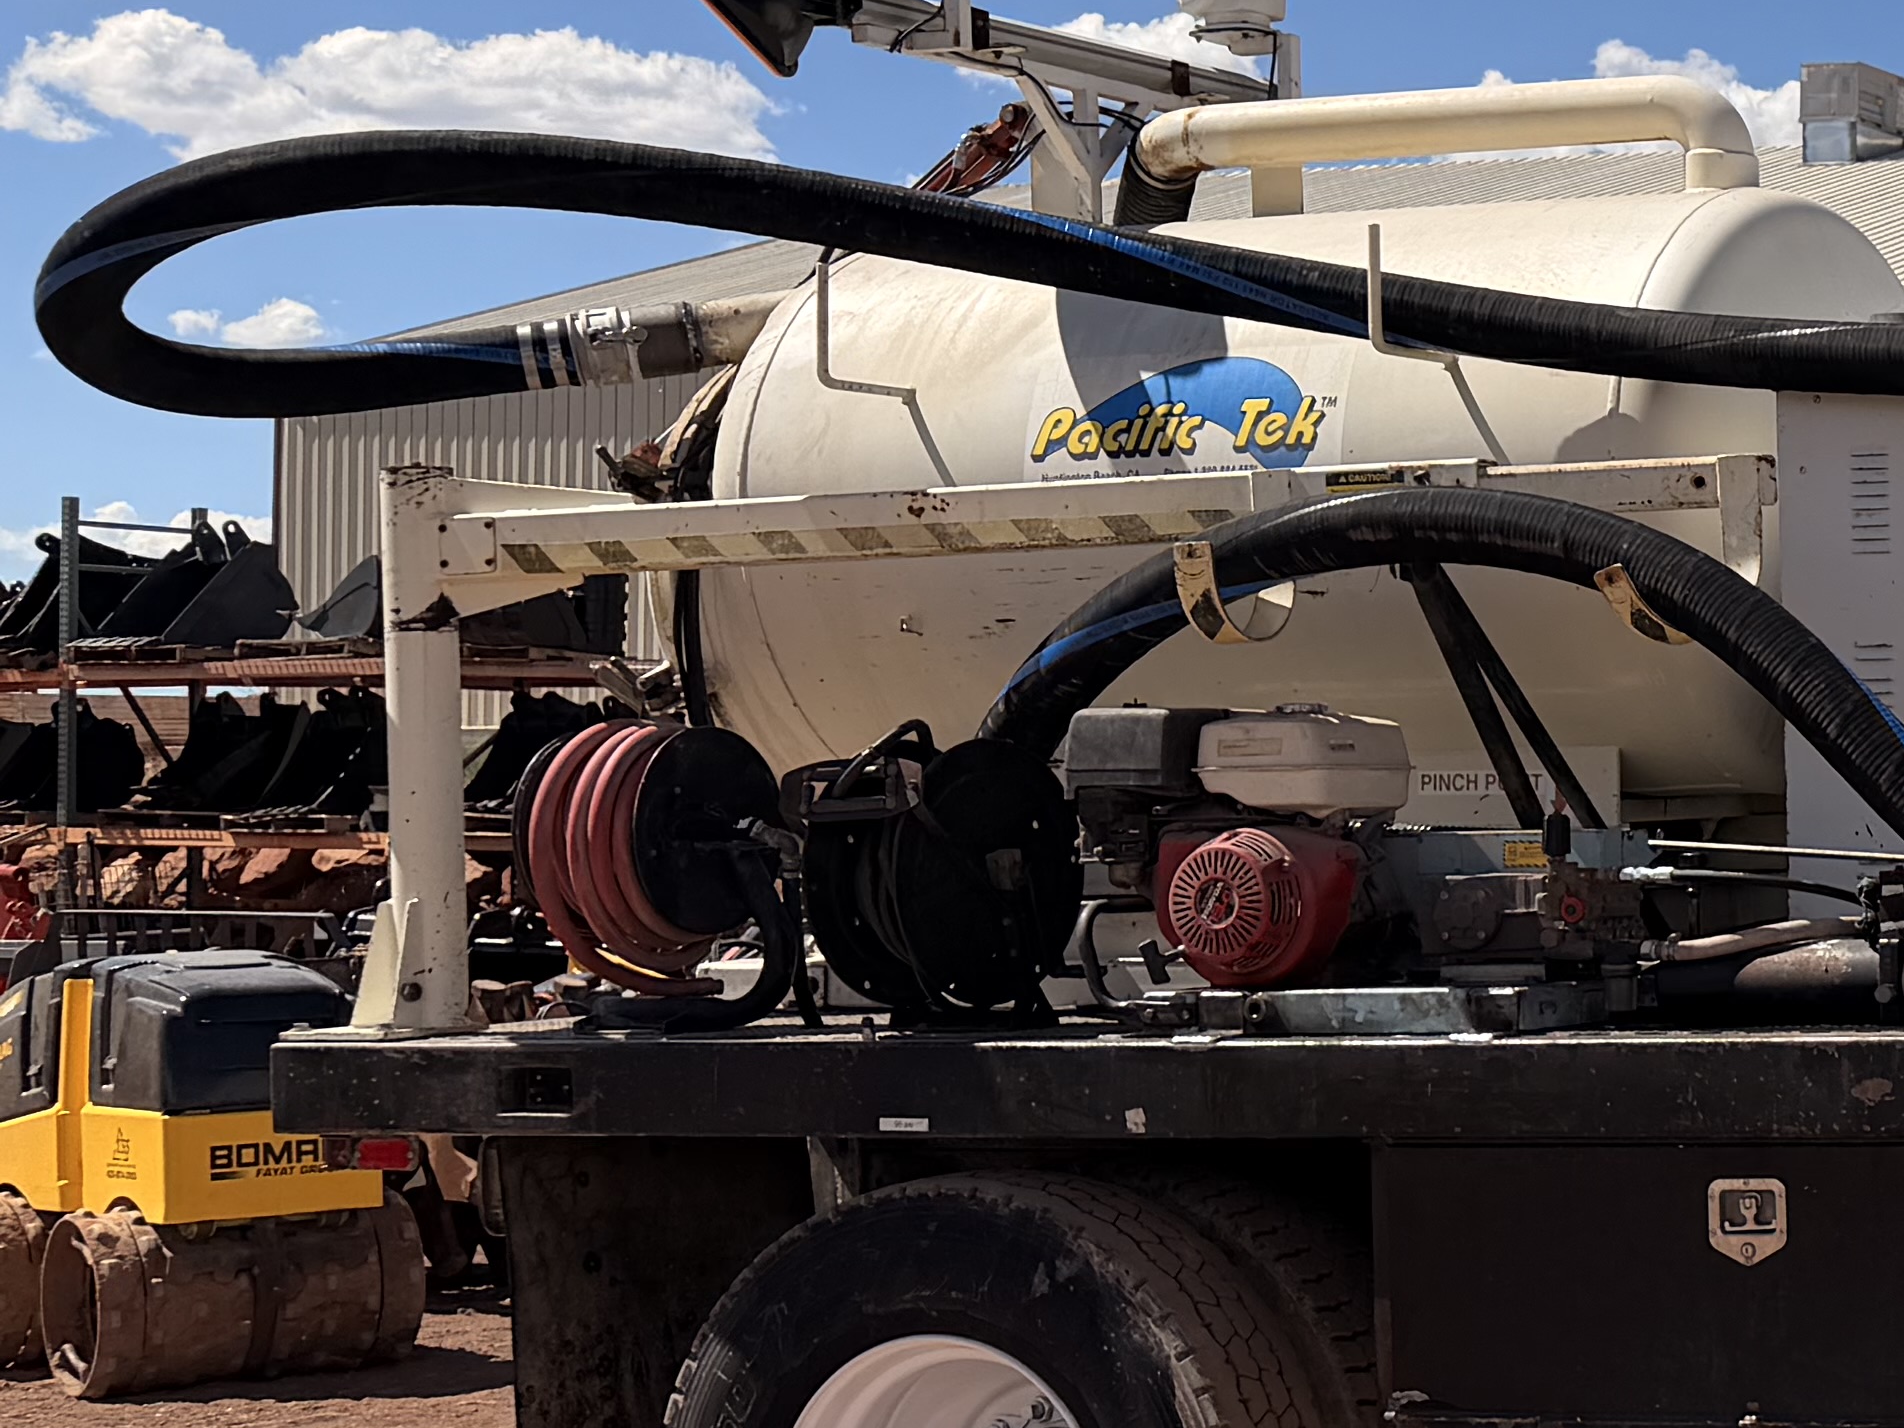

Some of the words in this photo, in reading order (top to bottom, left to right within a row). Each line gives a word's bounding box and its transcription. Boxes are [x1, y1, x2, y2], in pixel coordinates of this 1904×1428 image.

[1031, 401, 1203, 462] Pacific
[1233, 395, 1326, 453] Tek
[1420, 773, 1478, 791] PINCH
[210, 1139, 320, 1170] BOMA
[255, 1166, 296, 1178] FAYAT
